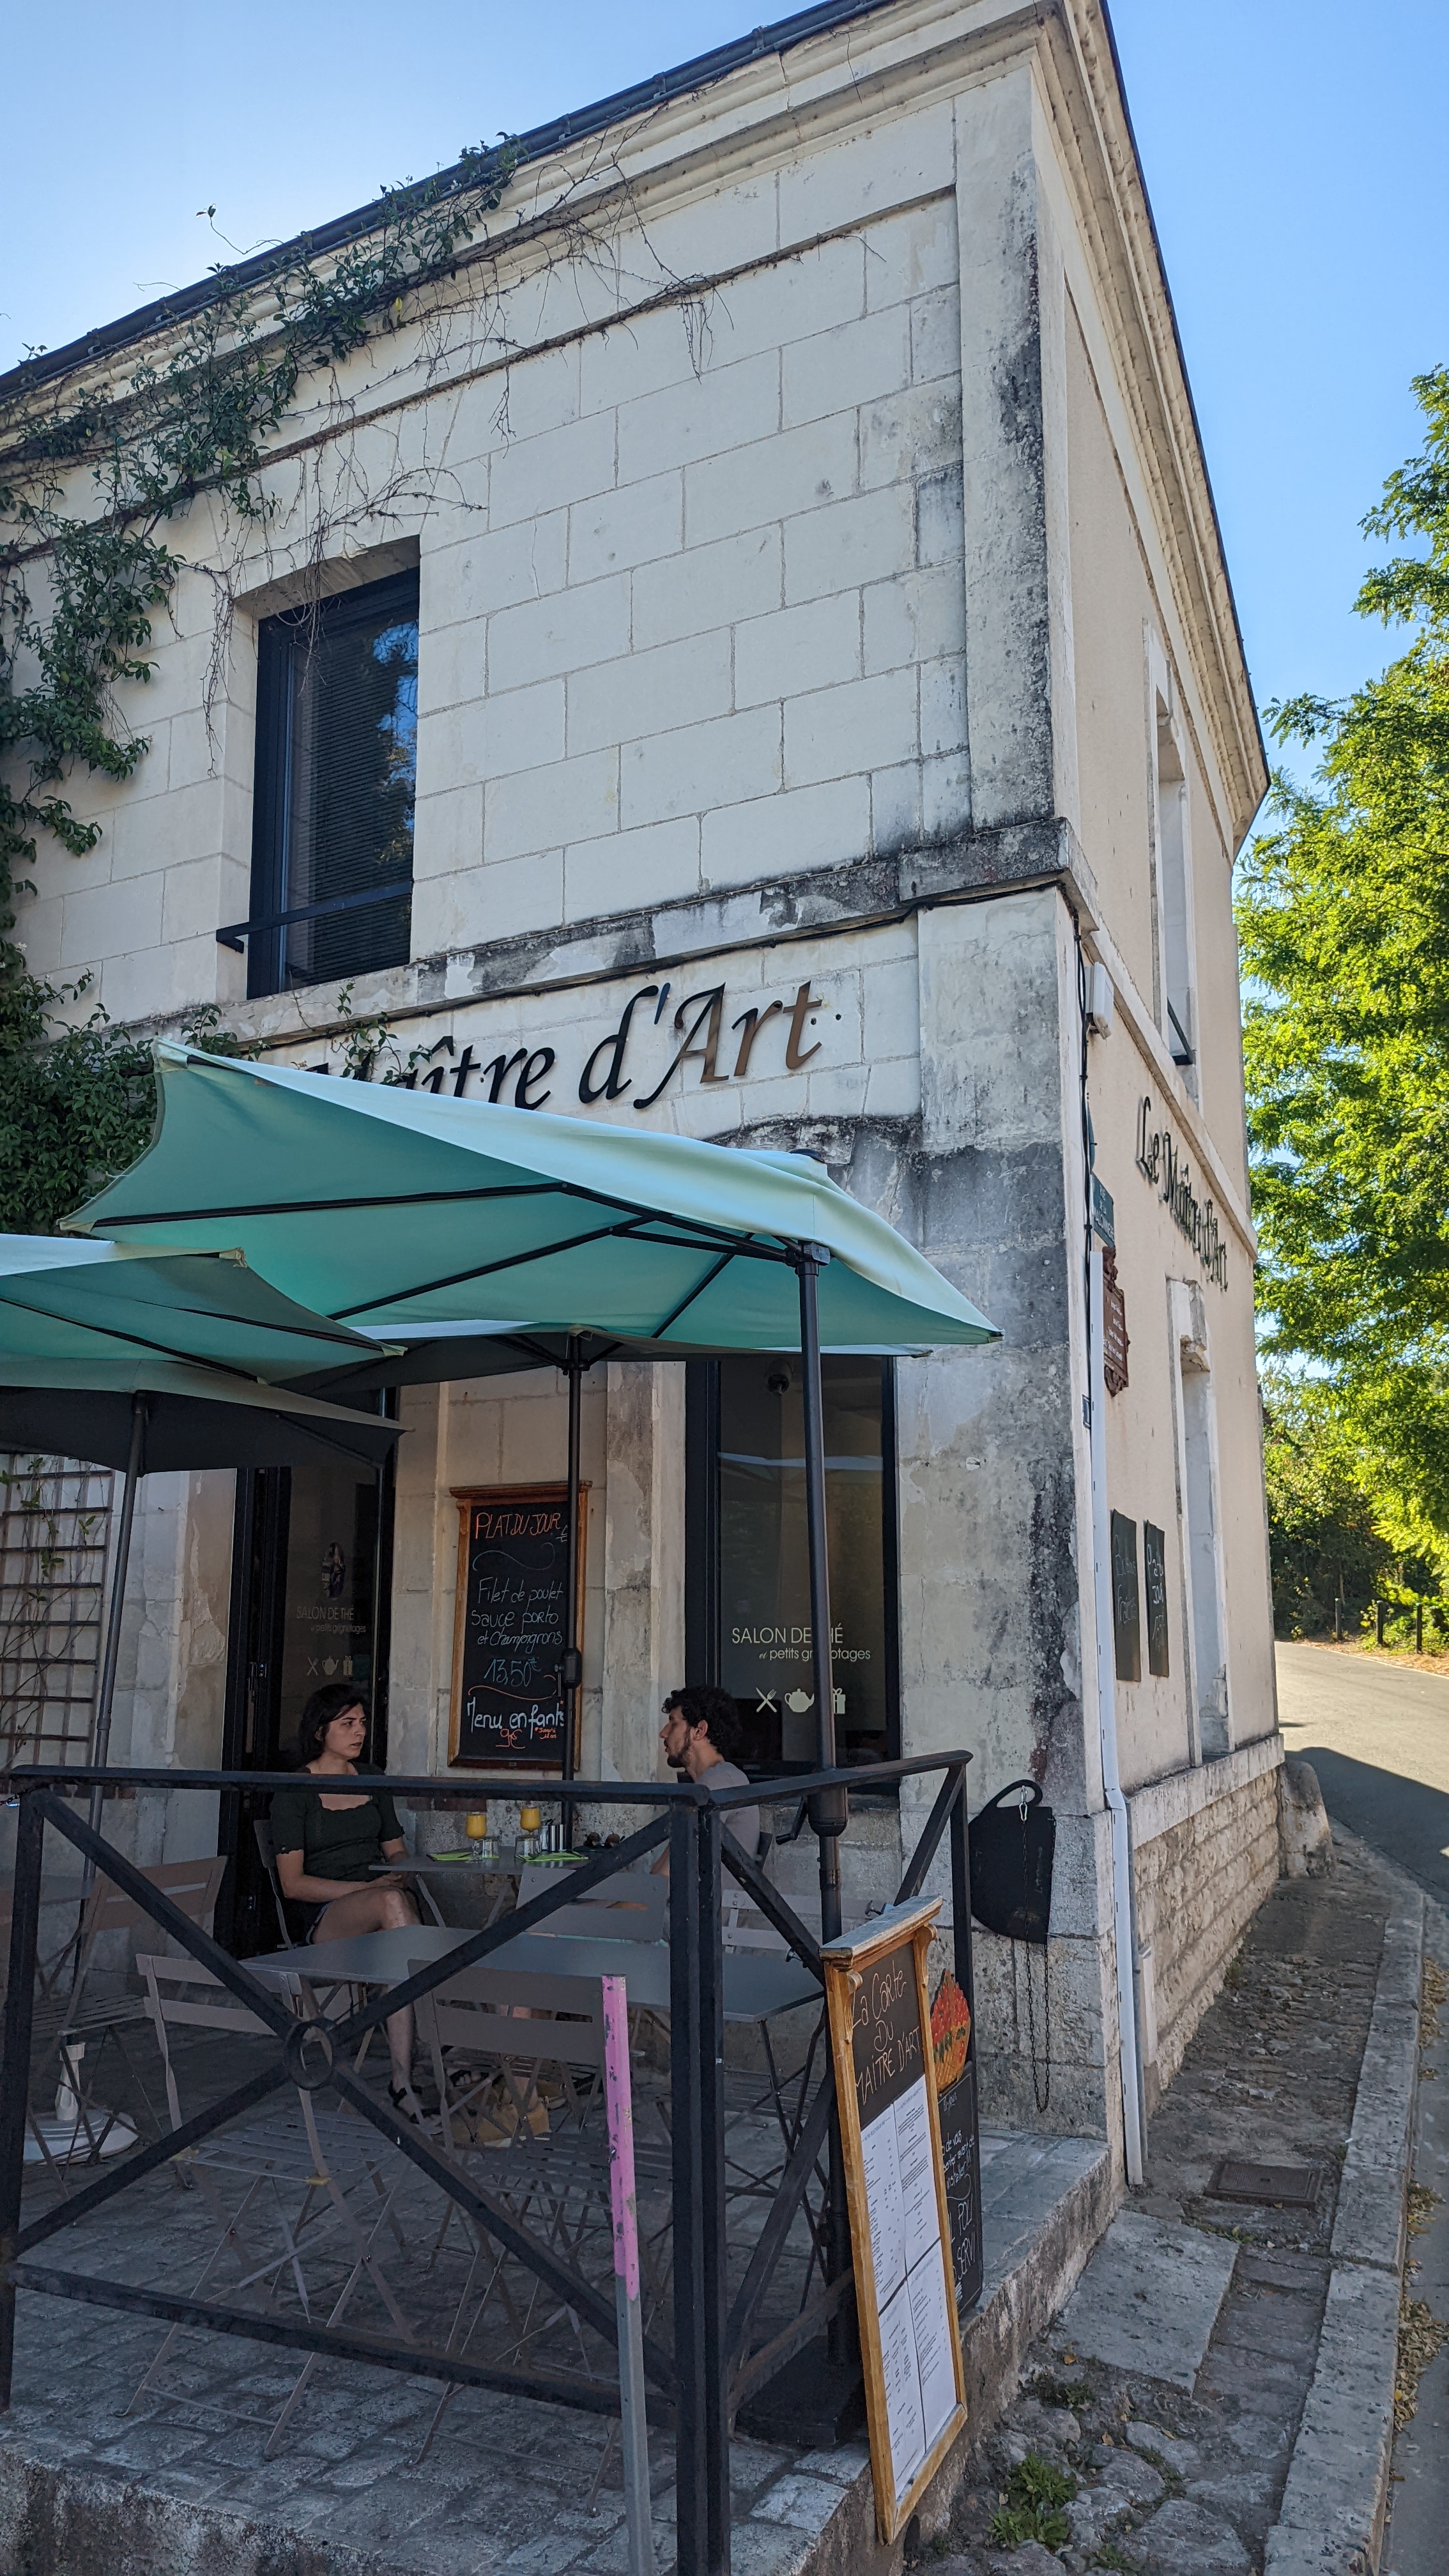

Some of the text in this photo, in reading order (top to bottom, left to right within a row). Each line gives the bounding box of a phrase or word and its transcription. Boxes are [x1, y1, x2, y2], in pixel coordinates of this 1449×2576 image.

[579, 980, 822, 1109] d'Art
[1139, 1096, 1160, 1184] Le
[475, 1512, 561, 1540] PLAT DU JOUR
[296, 1606, 326, 1620] SALON
[328, 1607, 339, 1620] DE
[478, 1576, 564, 1613] Filet de poulet
[477, 1630, 489, 1644] et
[732, 1627, 786, 1644] SALON
[791, 1627, 811, 1643] DE
[769, 1647, 799, 1661] petits
[801, 1647, 871, 1662] grotages
[466, 1696, 503, 1733] Menu
[897, 2026, 920, 2073] D'ART
[956, 2231, 976, 2280] SERVI
